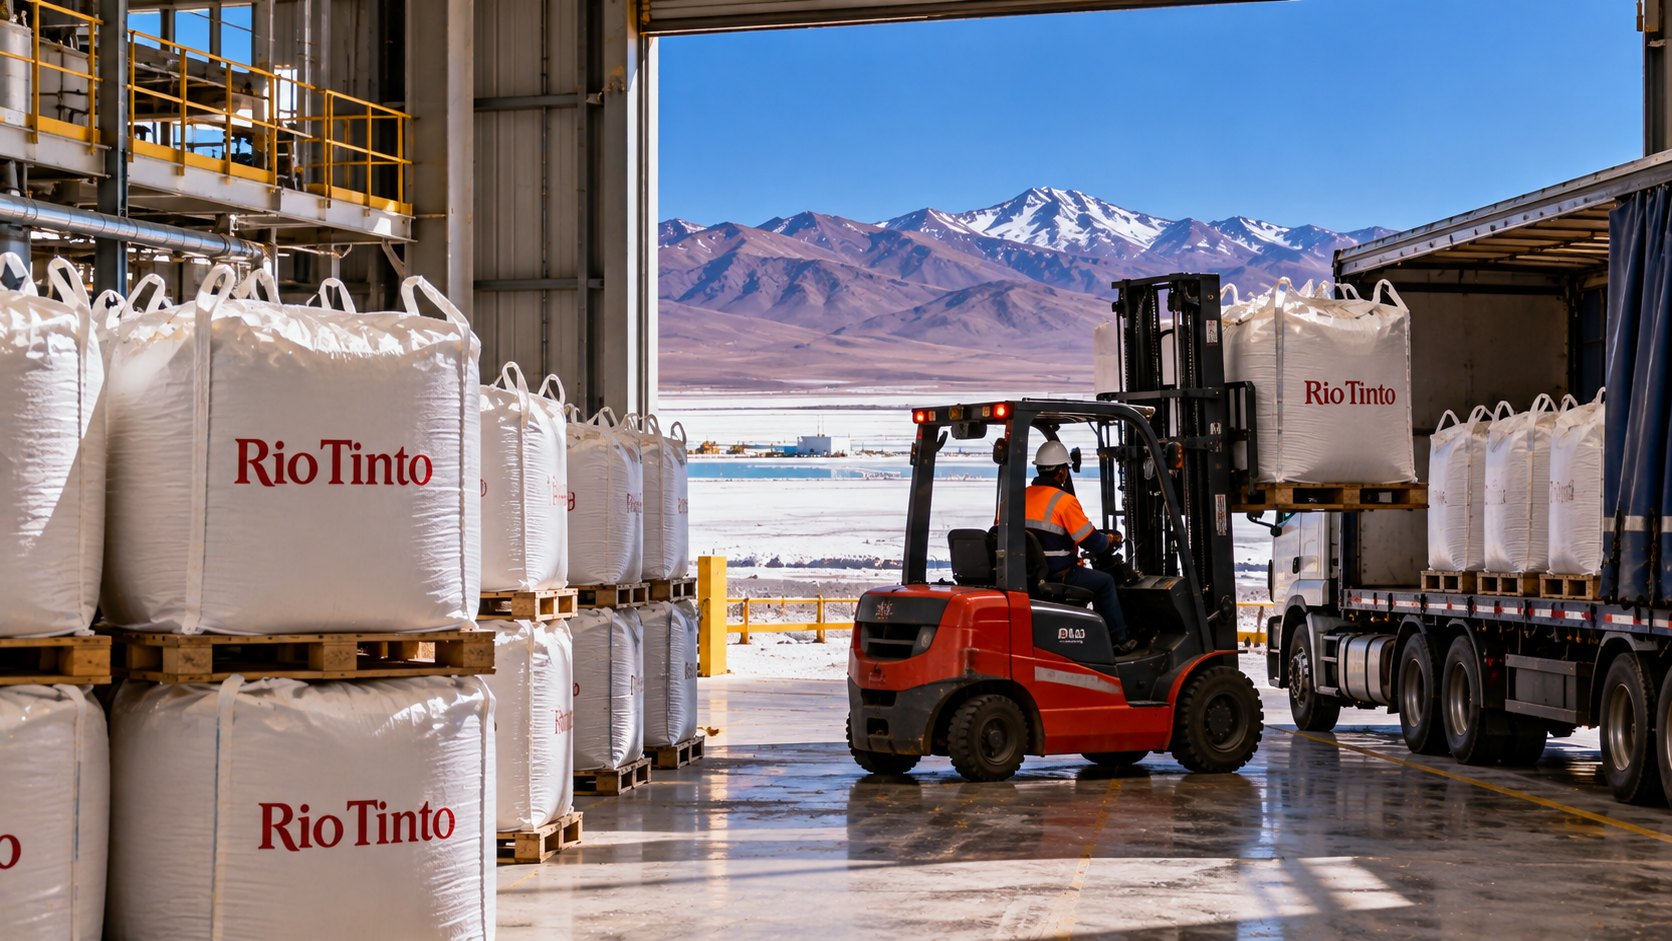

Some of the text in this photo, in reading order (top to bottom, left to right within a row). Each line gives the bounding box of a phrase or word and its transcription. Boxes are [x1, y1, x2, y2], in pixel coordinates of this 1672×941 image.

[1305, 380, 1396, 405] Rio Tinto
[234, 437, 433, 487] Rio Tinto
[258, 800, 456, 852] Rio Tinto
